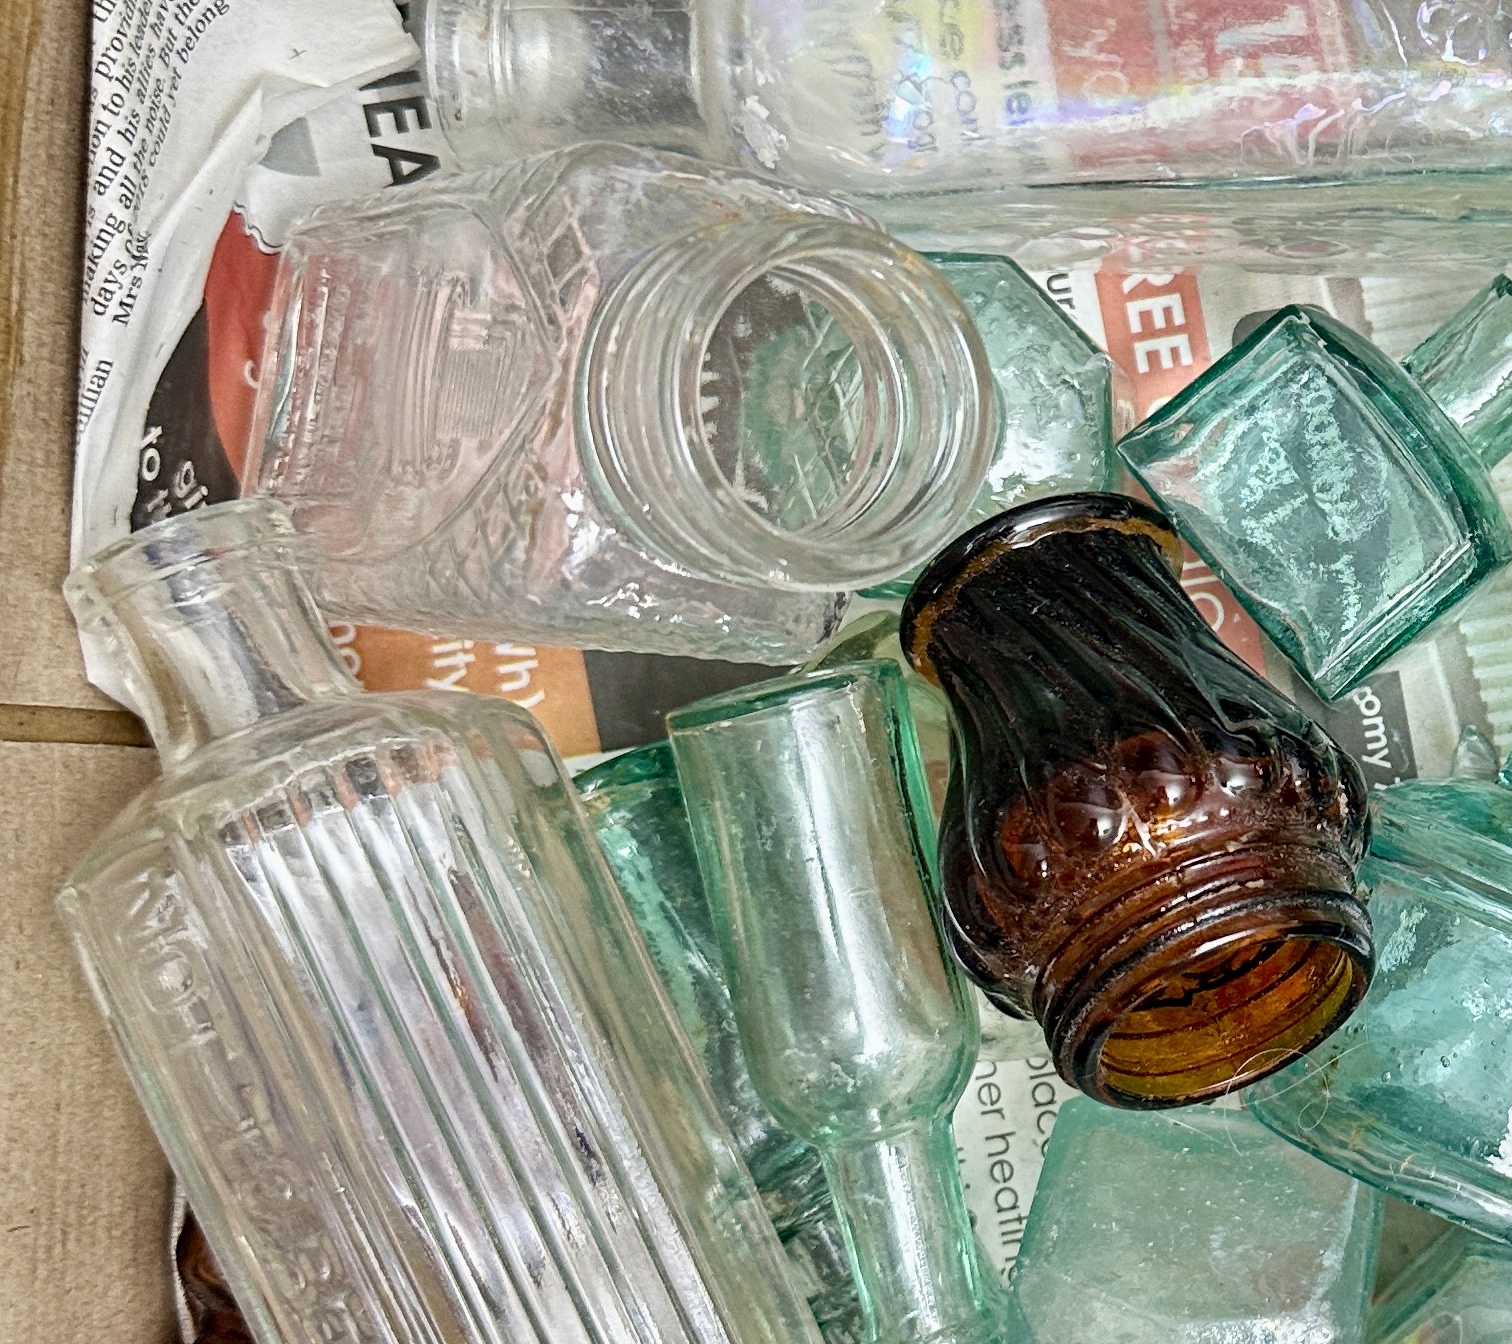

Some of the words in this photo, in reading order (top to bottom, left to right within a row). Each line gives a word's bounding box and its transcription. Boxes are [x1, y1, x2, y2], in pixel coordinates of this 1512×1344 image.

[93, 146, 126, 196] and
[117, 108, 141, 146] his
[135, 44, 157, 105] allies
[101, 92, 125, 117] to
[115, 57, 137, 93] his
[118, 174, 138, 210] all
[132, 136, 149, 174] the
[159, 27, 179, 68] But
[90, 258, 129, 317] days
[149, 103, 172, 167] could
[167, 66, 183, 107] yet
[111, 275, 143, 328] Mrs
